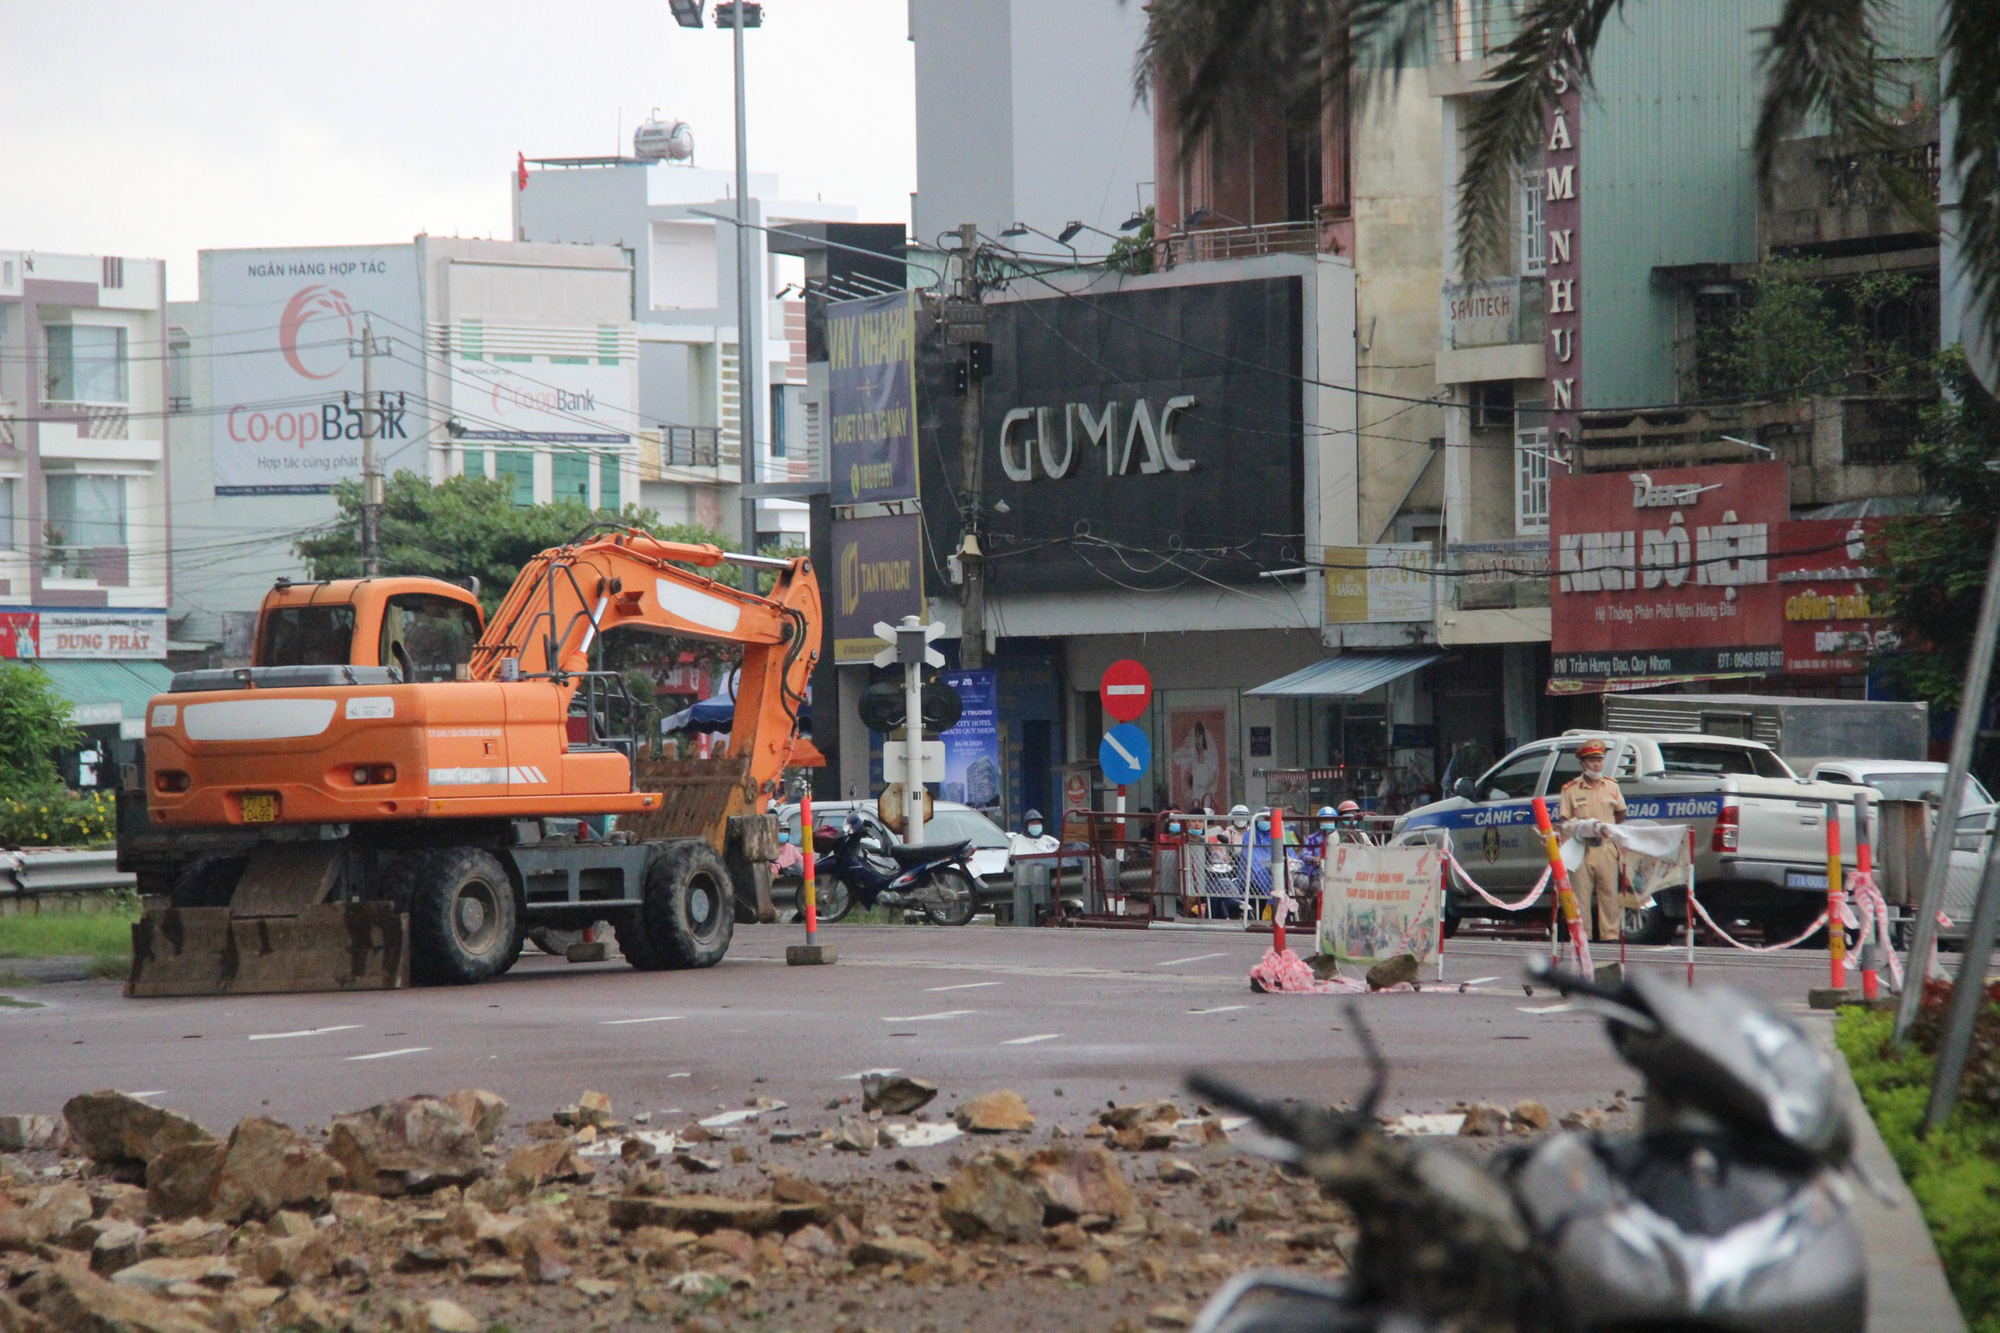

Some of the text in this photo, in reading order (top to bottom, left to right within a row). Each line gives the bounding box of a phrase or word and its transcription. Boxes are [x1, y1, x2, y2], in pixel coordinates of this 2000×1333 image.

[248, 259, 386, 276] NGÂN HÀNG HỢP TÁC
[1451, 296, 1509, 320] SAVITECH
[829, 307, 909, 371] VAY NHANH
[1550, 230, 1574, 461] NHUNG
[833, 414, 857, 444] CAVET
[876, 411, 887, 438] XE
[887, 402, 907, 437] MÁY
[1000, 395, 1196, 482] GUMAC
[258, 456, 280, 471] Hợp
[284, 456, 299, 469] tác
[303, 457, 329, 471] cùng
[333, 456, 358, 471] phát
[1560, 510, 1767, 600] KINH ĐÔ NỆM
[1401, 550, 1428, 584] 612
[1595, 600, 1736, 624] Hệ Thống Phân Phối Nệm Hàng Đầu
[1554, 658, 1567, 674] 610
[1569, 655, 1588, 673] Trần
[1589, 657, 1611, 676] Hưng
[1612, 656, 1630, 675] Đạo,
[1631, 656, 1647, 675] Quy
[1718, 652, 1733, 668] ĐT:
[962, 728, 976, 736] QUY
[247, 809, 271, 820] 0499
[1475, 808, 1512, 825] CẢNH
[1626, 798, 1718, 817] GIAO THÔNG
